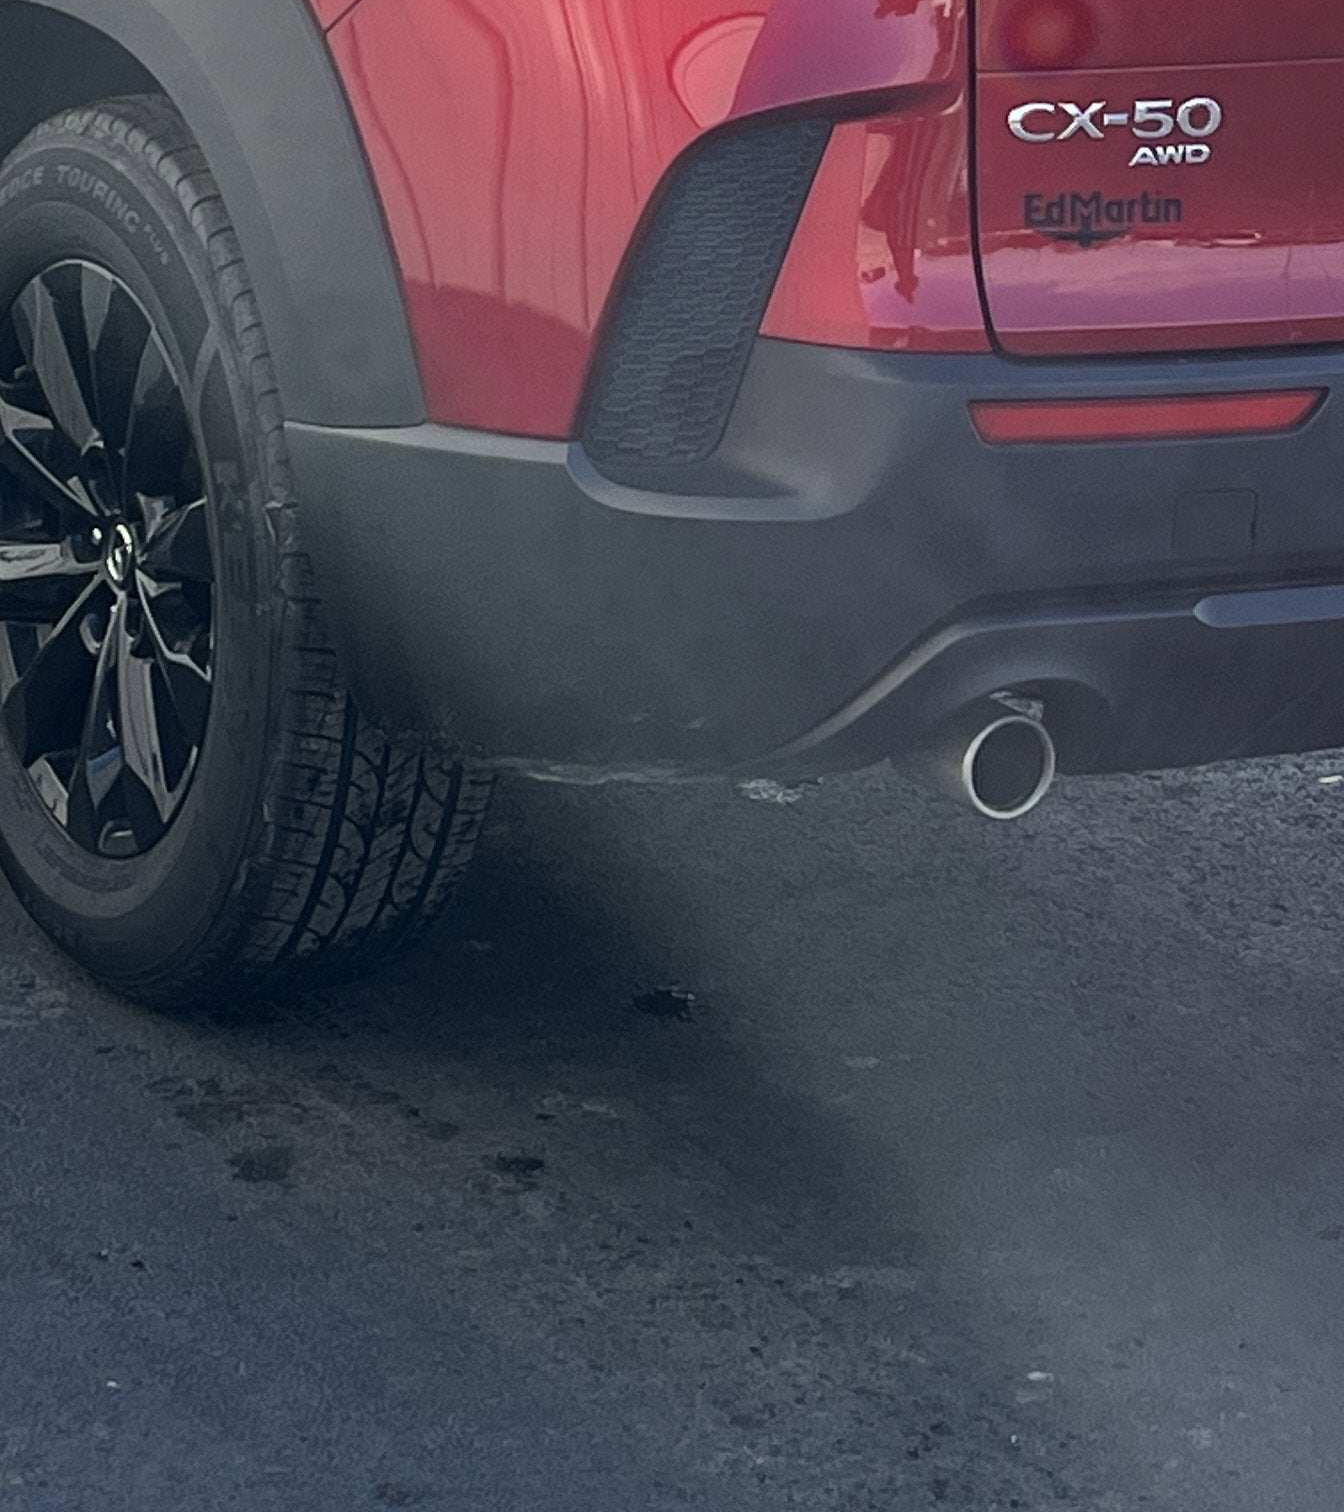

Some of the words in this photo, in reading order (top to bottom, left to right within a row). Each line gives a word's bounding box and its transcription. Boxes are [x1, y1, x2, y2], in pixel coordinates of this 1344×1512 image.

[1007, 96, 1222, 142] CX-50
[1128, 143, 1211, 167] AWD
[1023, 190, 1184, 228] EdMartin
